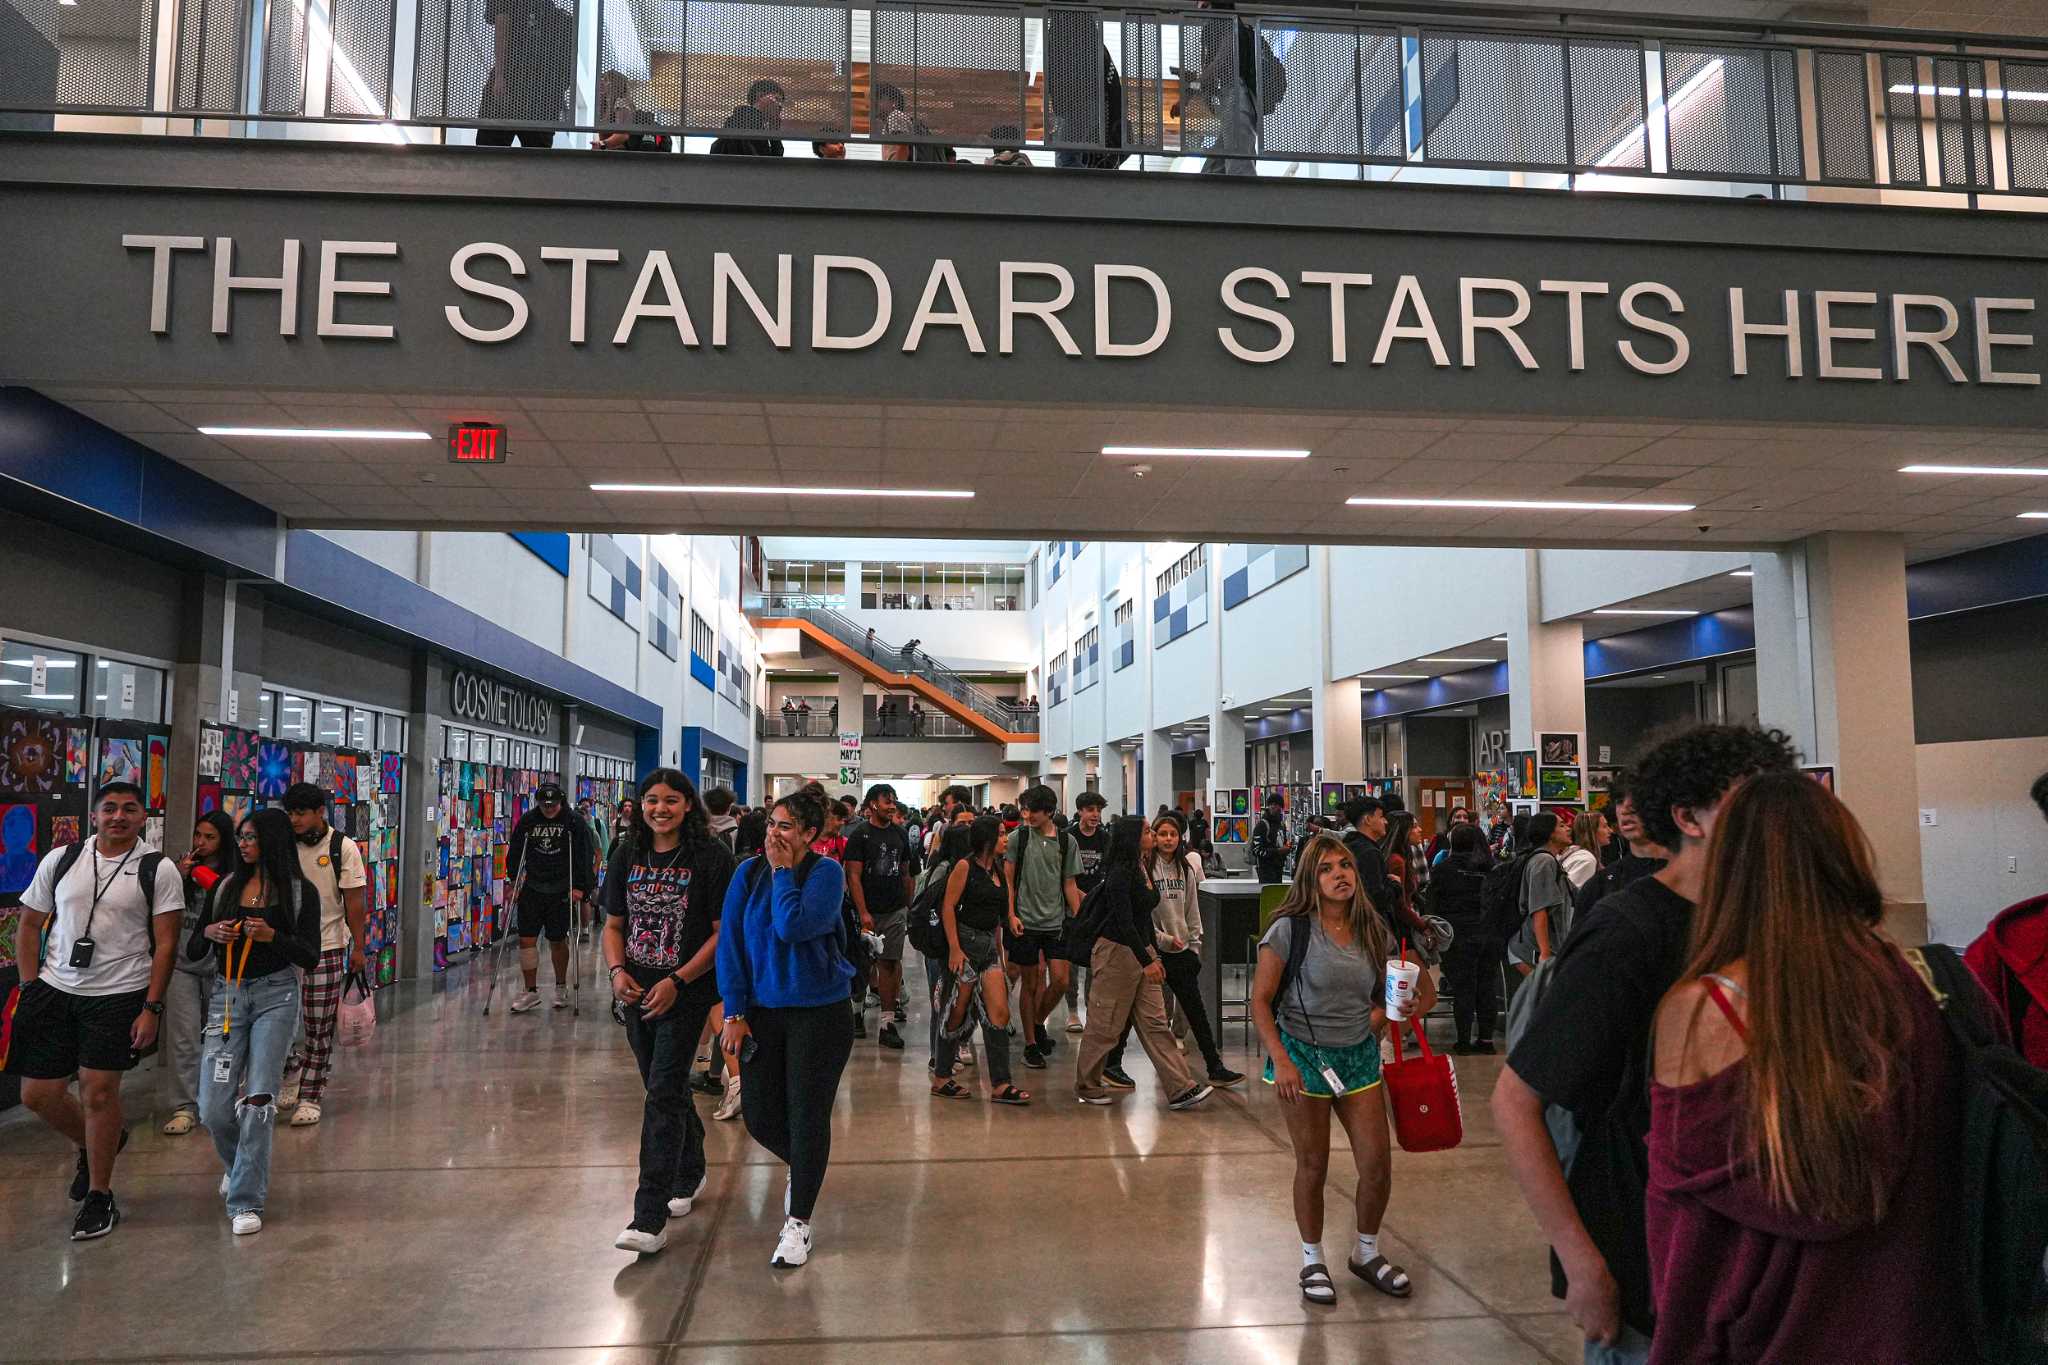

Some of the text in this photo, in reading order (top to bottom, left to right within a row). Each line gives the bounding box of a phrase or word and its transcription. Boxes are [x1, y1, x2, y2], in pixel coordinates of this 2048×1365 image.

[121, 234, 2042, 386] THE STANDARD STARTS HERE
[457, 428, 499, 460] EXIT
[453, 671, 553, 735] COSMETOLOGY
[840, 750, 853, 761] MAY
[532, 827, 564, 837] NAVY
